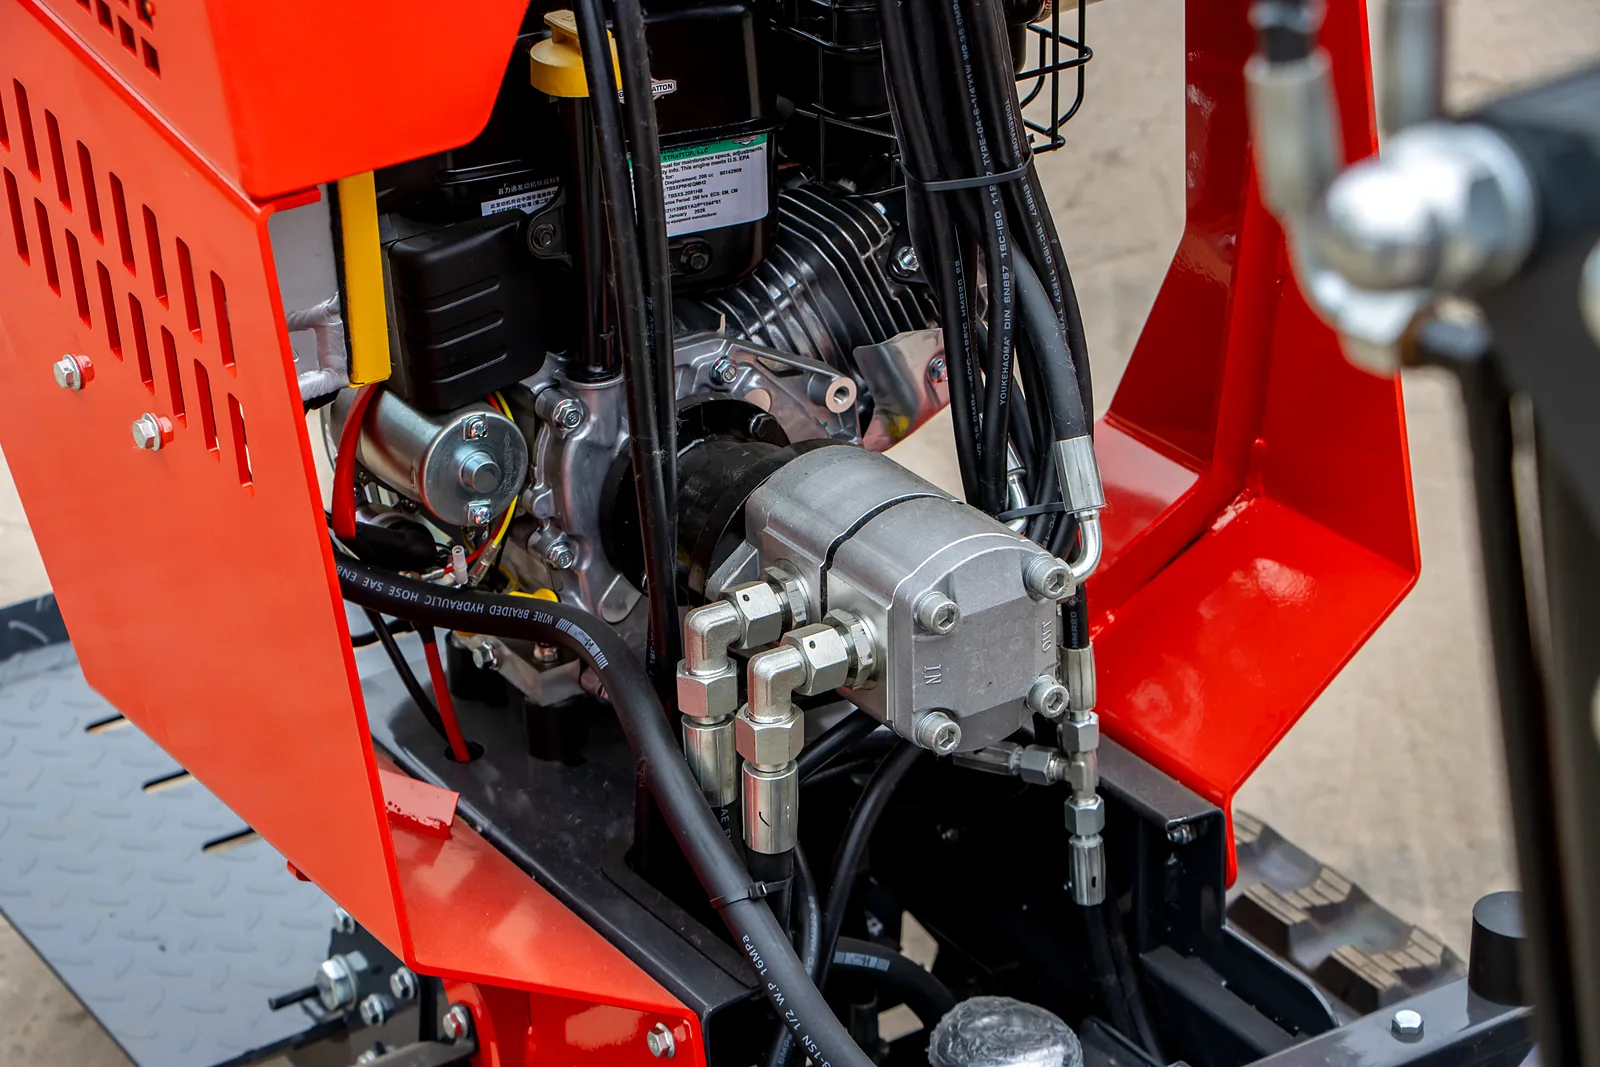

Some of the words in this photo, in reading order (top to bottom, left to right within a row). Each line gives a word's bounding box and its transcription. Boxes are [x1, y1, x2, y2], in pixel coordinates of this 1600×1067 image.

[652, 83, 673, 92] ATTON
[682, 156, 714, 166] maintenance
[693, 162, 710, 171] engine
[711, 160, 727, 168] meets
[986, 171, 998, 206] 1127
[1057, 308, 1066, 330] TYP
[336, 564, 358, 582] EN8
[362, 576, 384, 592] SAE
[388, 586, 418, 602] HOSE
[424, 594, 485, 613] HYDRAULIC
[489, 605, 530, 620] BRAIDED
[532, 611, 554, 624] WIRE
[1041, 619, 1052, 654] OUT
[924, 664, 942, 685] IN
[720, 808, 730, 823] AE
[742, 934, 768, 976] 16MPa
[768, 982, 785, 1006] W.P
[785, 1009, 801, 1031] 1/2
